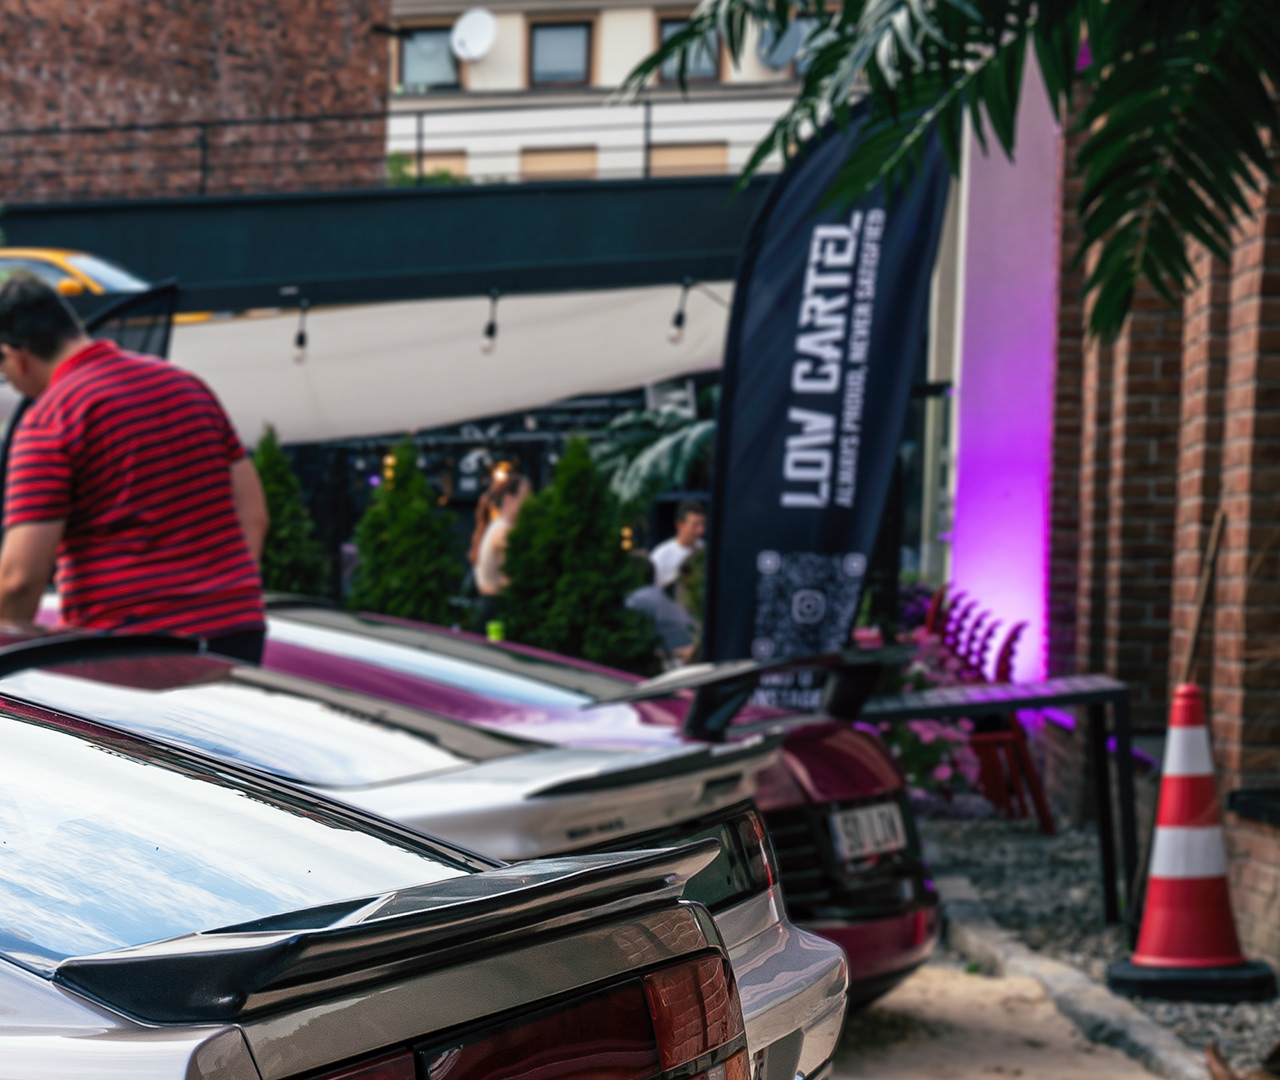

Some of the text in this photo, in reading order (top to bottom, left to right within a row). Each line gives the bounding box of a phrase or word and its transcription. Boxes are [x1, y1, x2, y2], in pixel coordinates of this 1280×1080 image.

[854, 208, 886, 300] SATISFIED
[780, 210, 863, 508] LOW CARTEL
[848, 303, 874, 363] NEVER
[835, 433, 861, 508] ALWAYS
